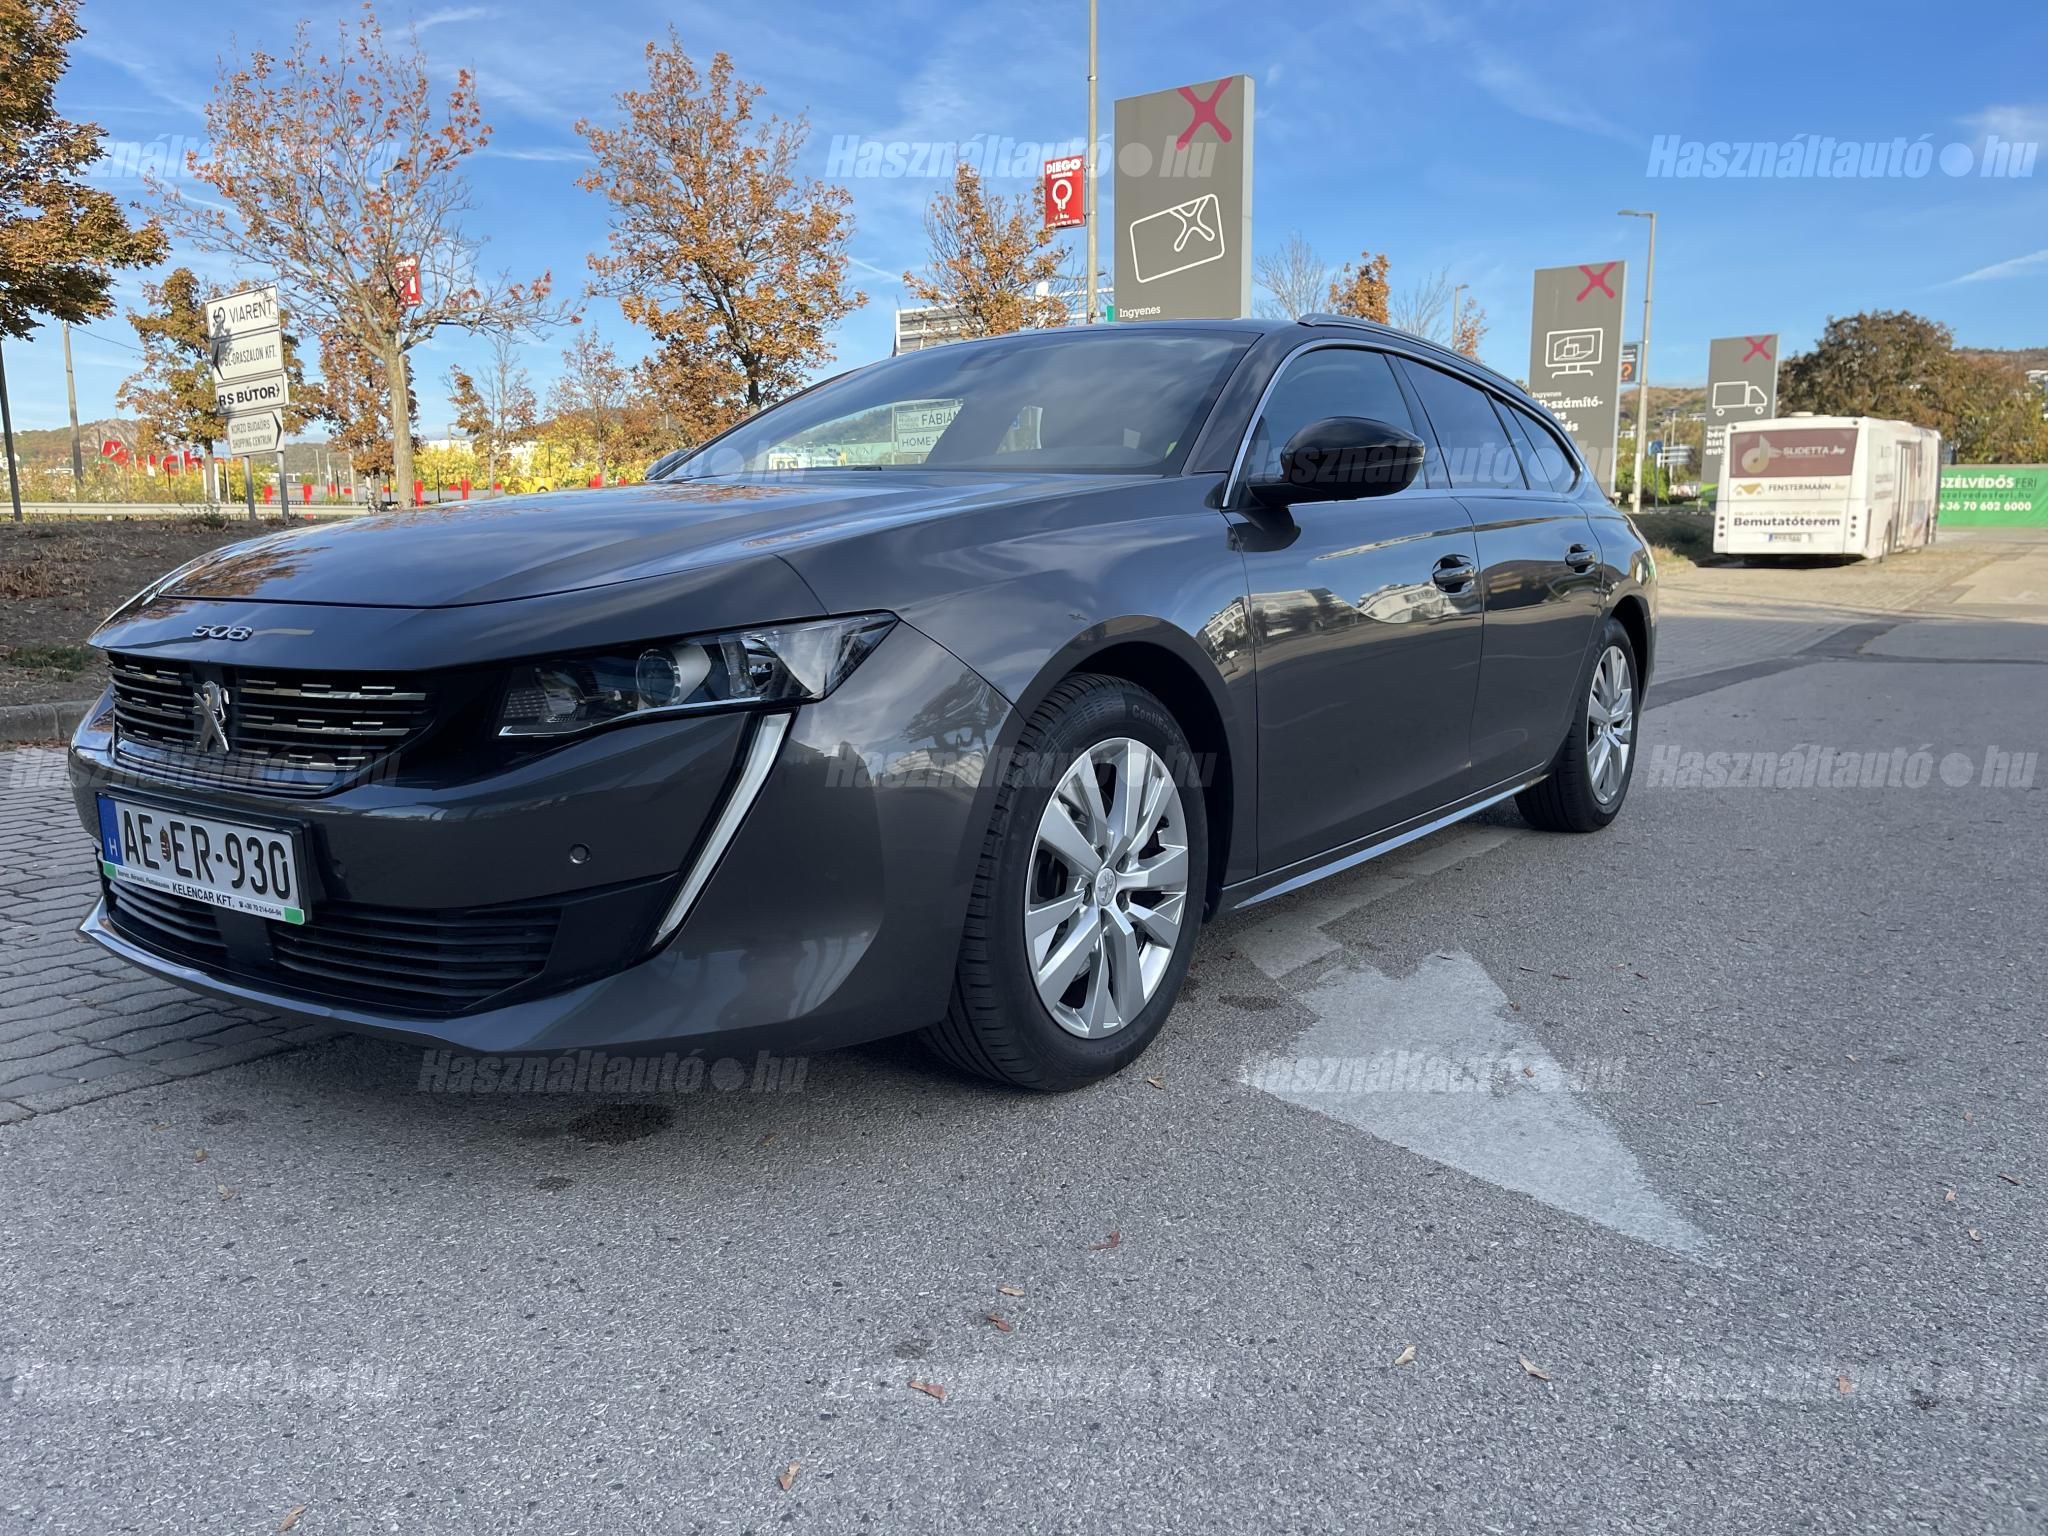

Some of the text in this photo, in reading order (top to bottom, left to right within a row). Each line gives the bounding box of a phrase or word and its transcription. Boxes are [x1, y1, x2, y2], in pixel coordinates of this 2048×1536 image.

[1046, 158, 1081, 174] DIEGO
[229, 300, 272, 323] VIARENT
[1119, 306, 1161, 319] Ingyenes
[218, 386, 276, 406] RS BÚTOR
[1939, 501, 2032, 511] +36 70 602 6000
[1733, 516, 1841, 527] Bemutatóterem
[192, 625, 253, 641] 508
[172, 882, 215, 903] KELENCAR
